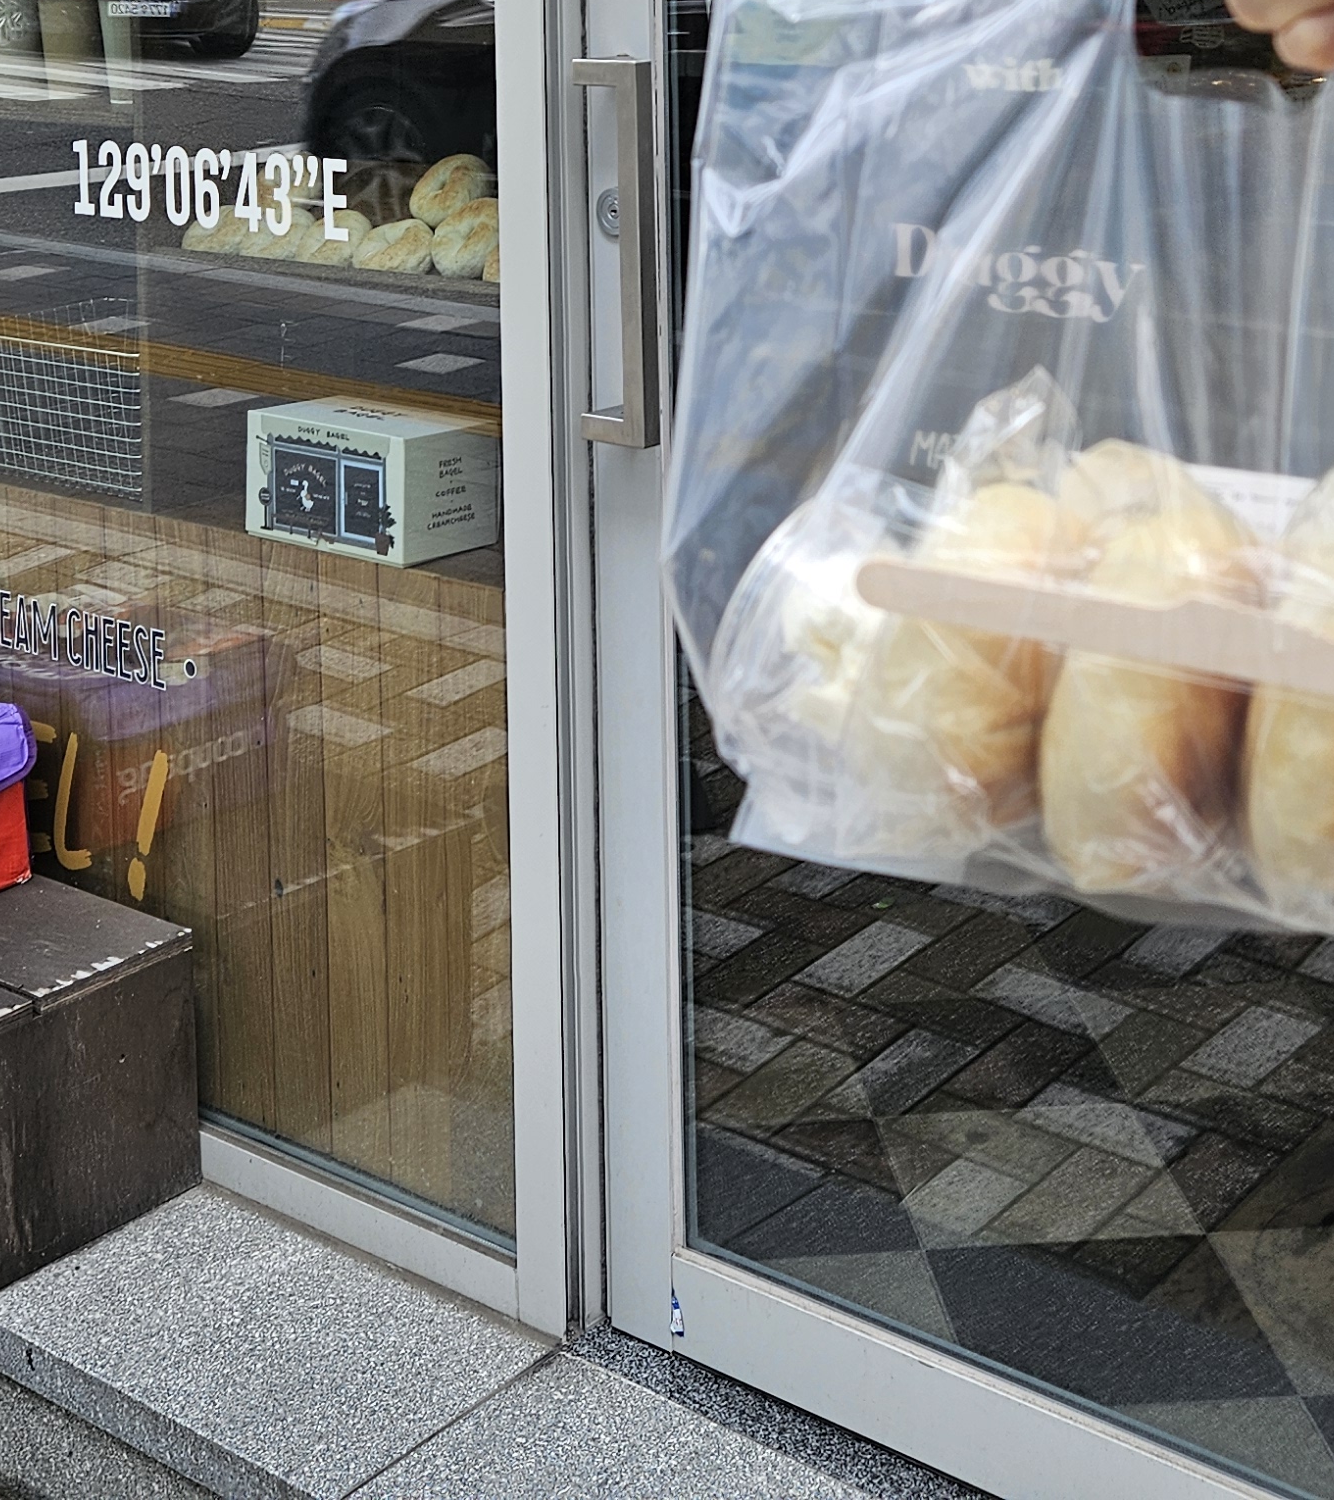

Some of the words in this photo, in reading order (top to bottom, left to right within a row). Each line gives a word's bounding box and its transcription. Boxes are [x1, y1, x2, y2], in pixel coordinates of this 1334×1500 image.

[438, 456, 462, 469] FRESH
[438, 466, 463, 479] BAGEL
[435, 486, 467, 498] COFFEE
[65, 607, 167, 692] CHEESE
